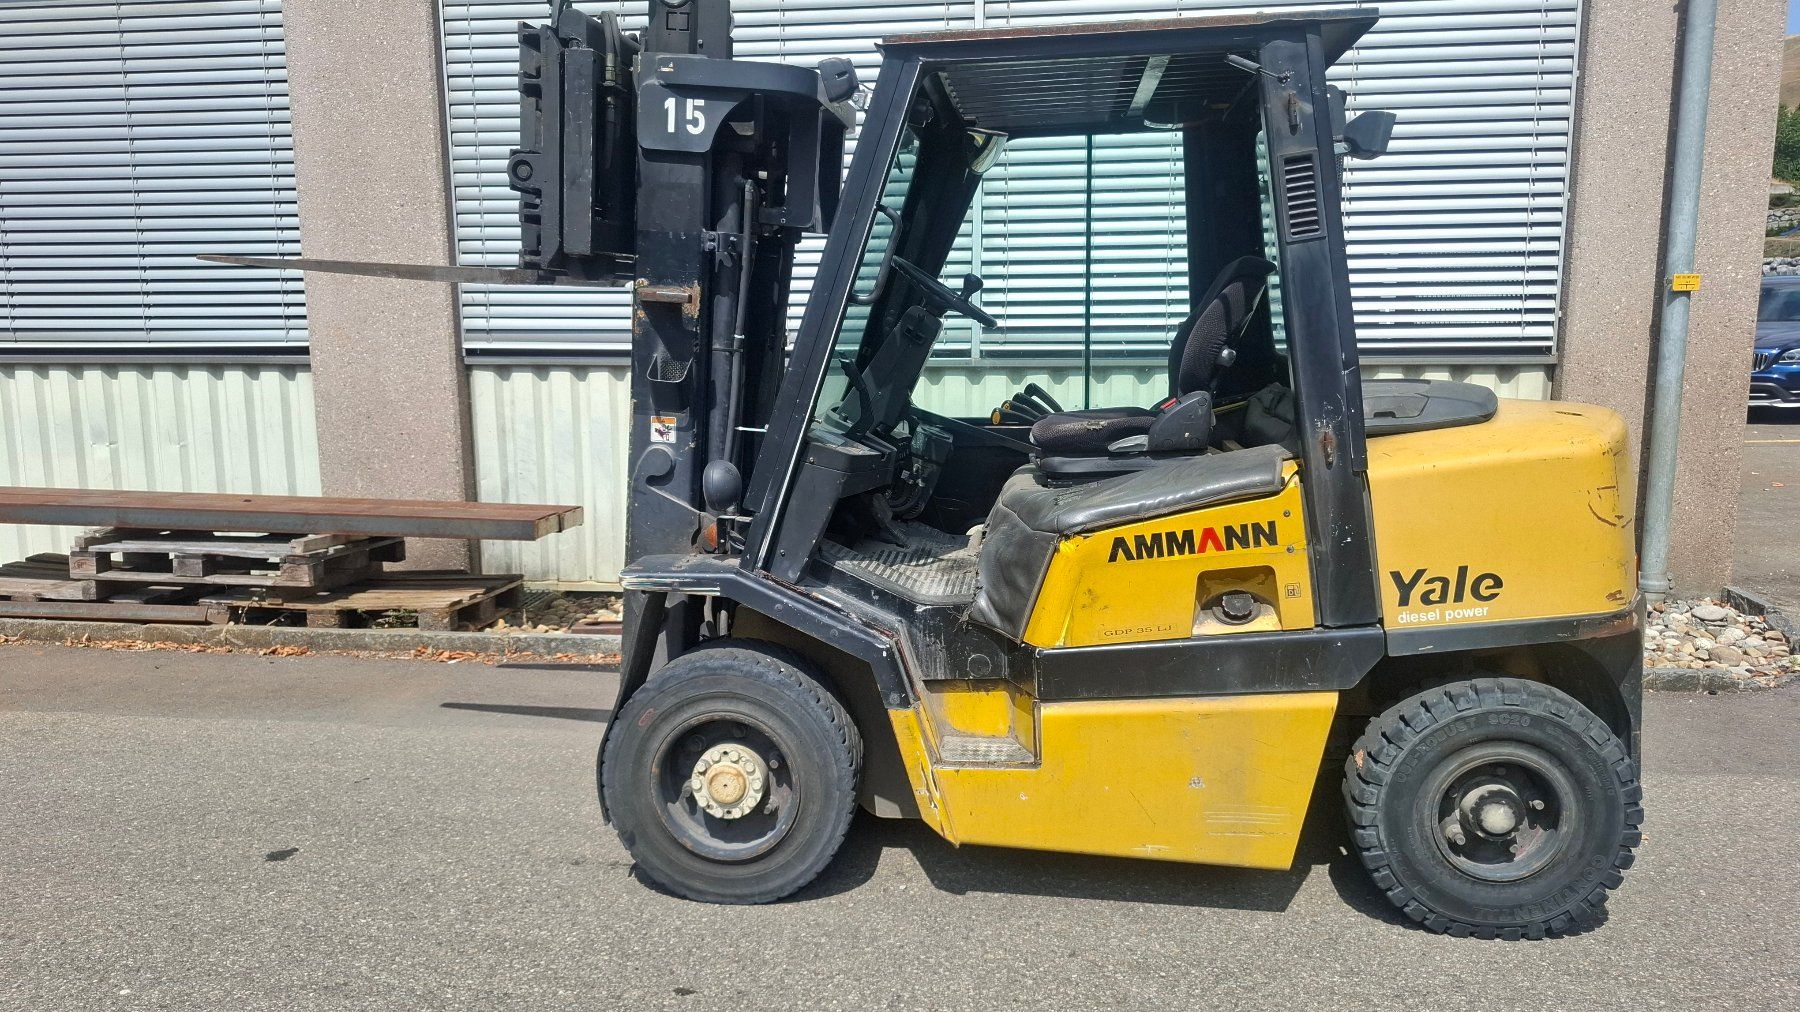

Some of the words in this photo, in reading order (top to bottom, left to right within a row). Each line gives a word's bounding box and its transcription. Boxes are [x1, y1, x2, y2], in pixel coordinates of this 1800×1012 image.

[664, 97, 706, 135] 15
[1108, 520, 1279, 563] AMMANN
[1389, 565, 1504, 608] Yale
[1103, 628, 1133, 637] GDP
[1136, 626, 1153, 634] 35
[1397, 608, 1440, 624] diesel
[1445, 606, 1489, 622] power
